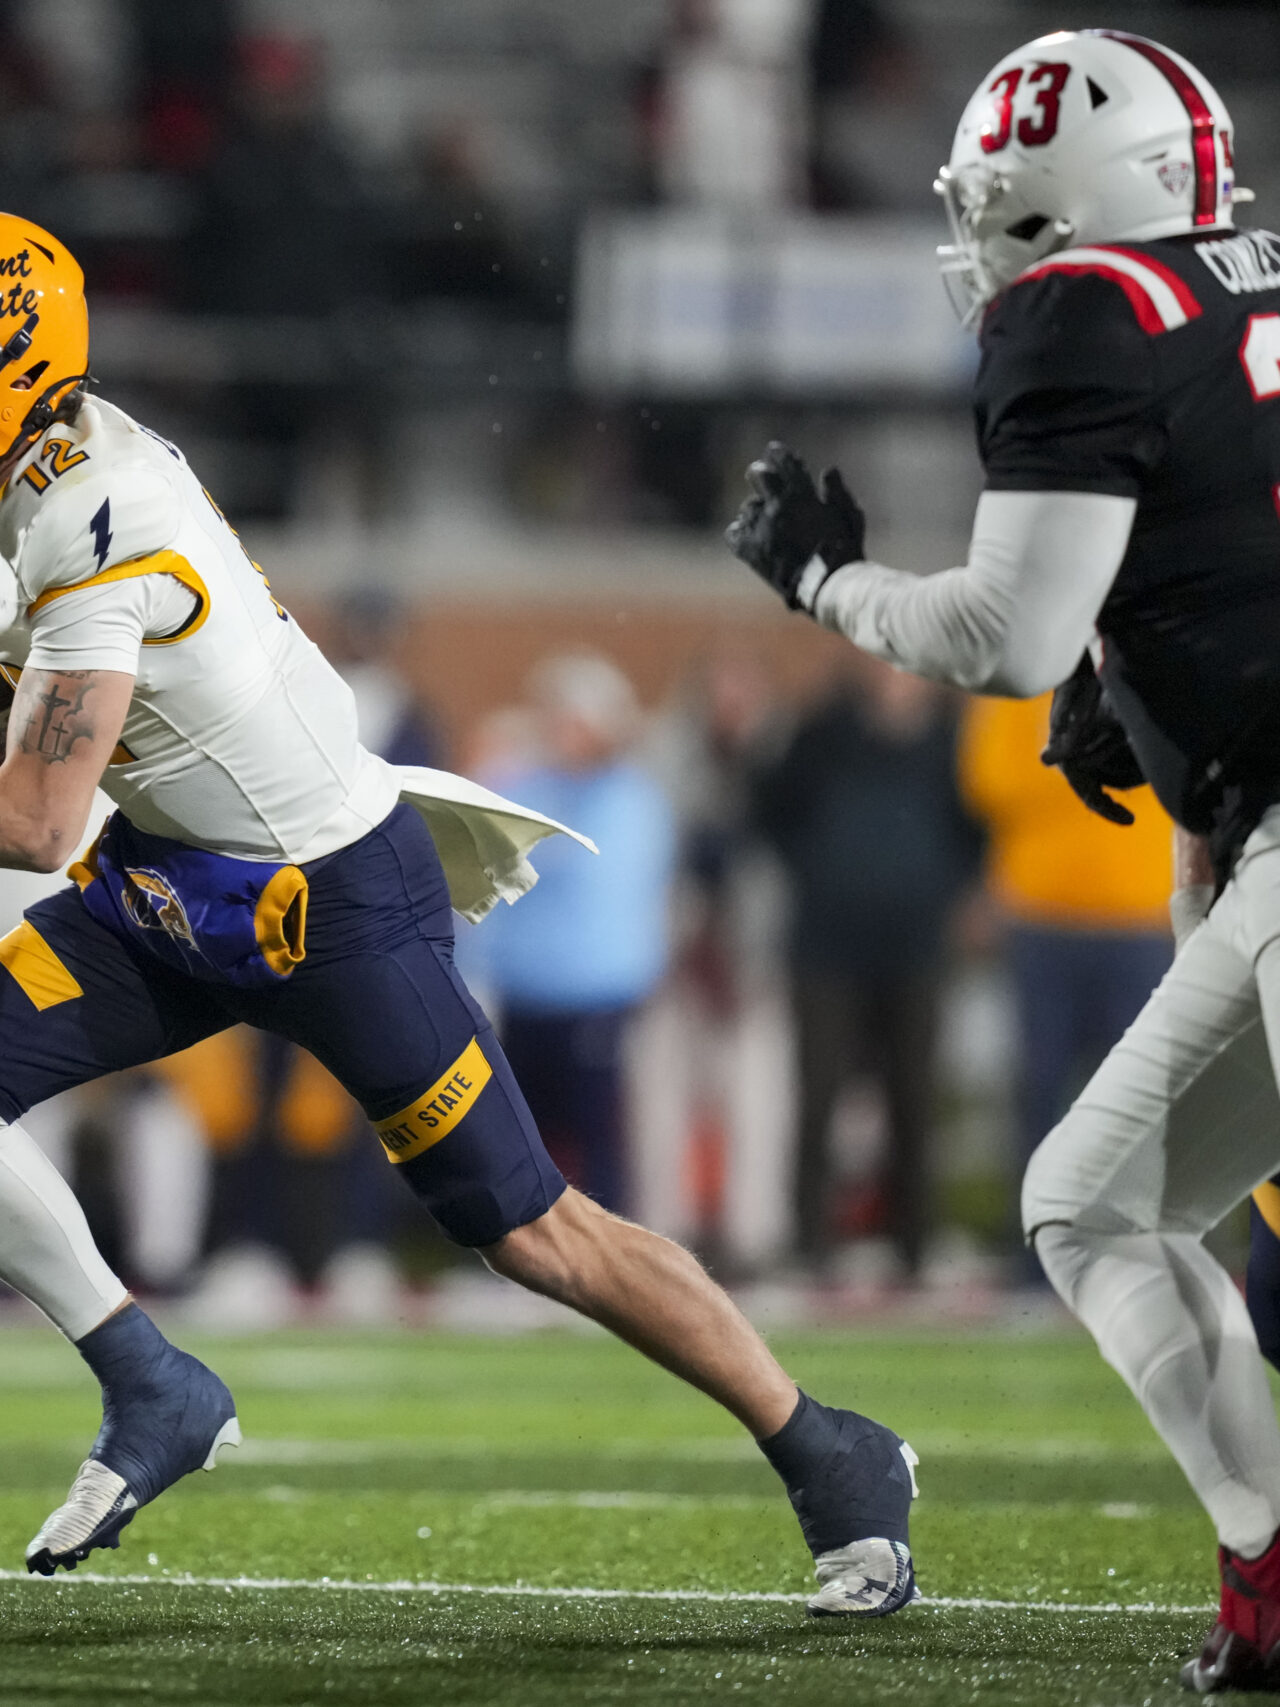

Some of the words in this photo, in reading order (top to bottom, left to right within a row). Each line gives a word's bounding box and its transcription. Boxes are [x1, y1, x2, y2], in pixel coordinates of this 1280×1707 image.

[980, 62, 1071, 154] 33
[15, 437, 90, 496] 12
[417, 1071, 473, 1128] STATE
